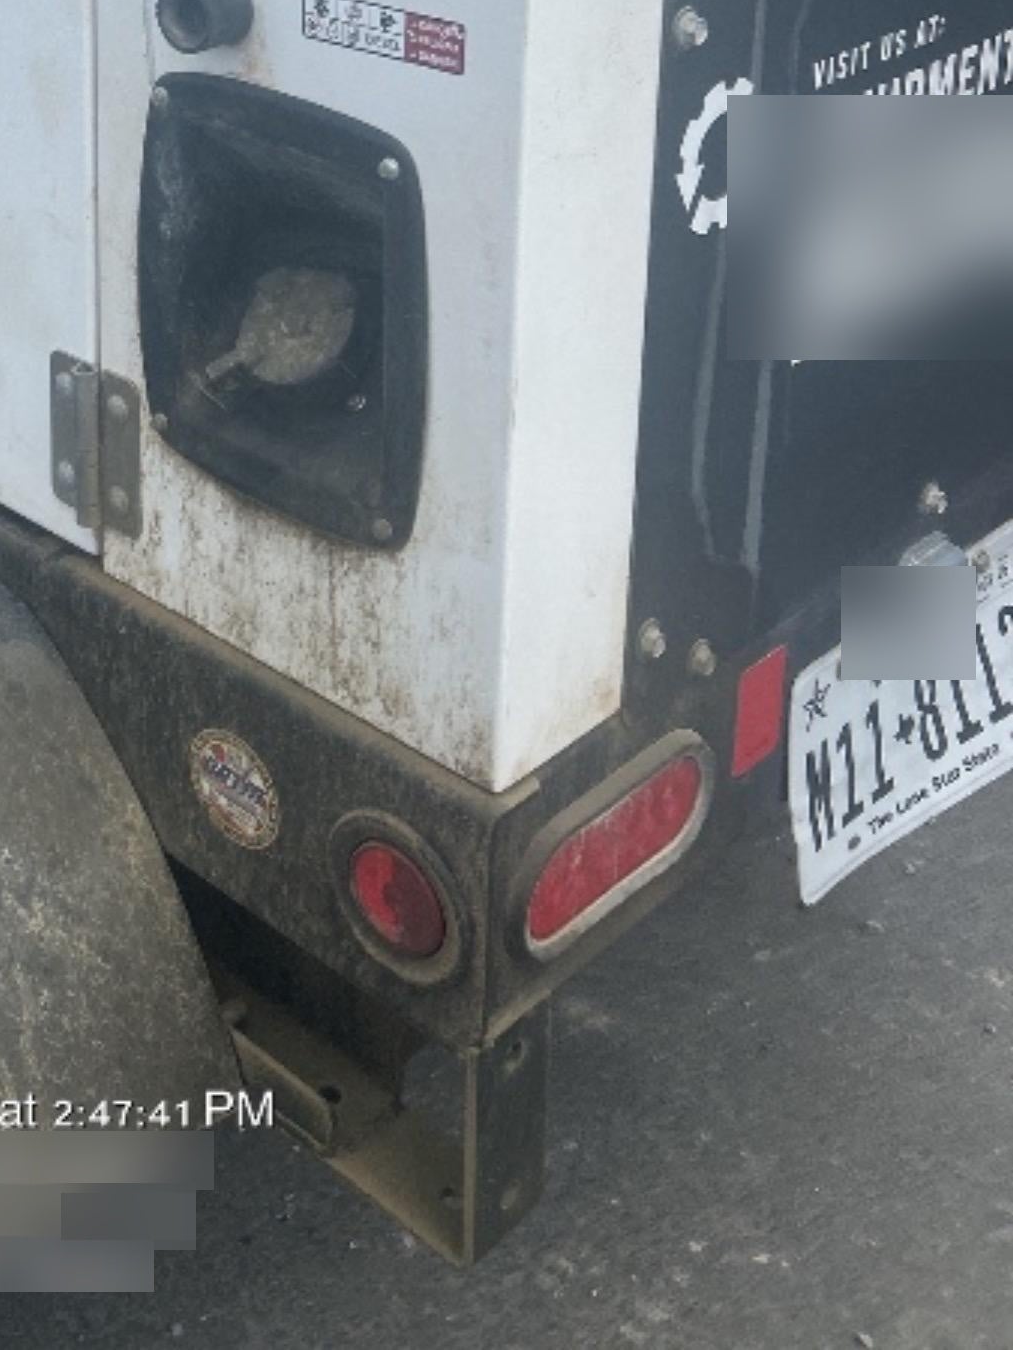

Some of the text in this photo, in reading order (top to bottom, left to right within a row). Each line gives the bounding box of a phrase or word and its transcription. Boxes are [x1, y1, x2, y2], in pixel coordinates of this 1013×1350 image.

[813, 14, 945, 90] VISIT US AT:
